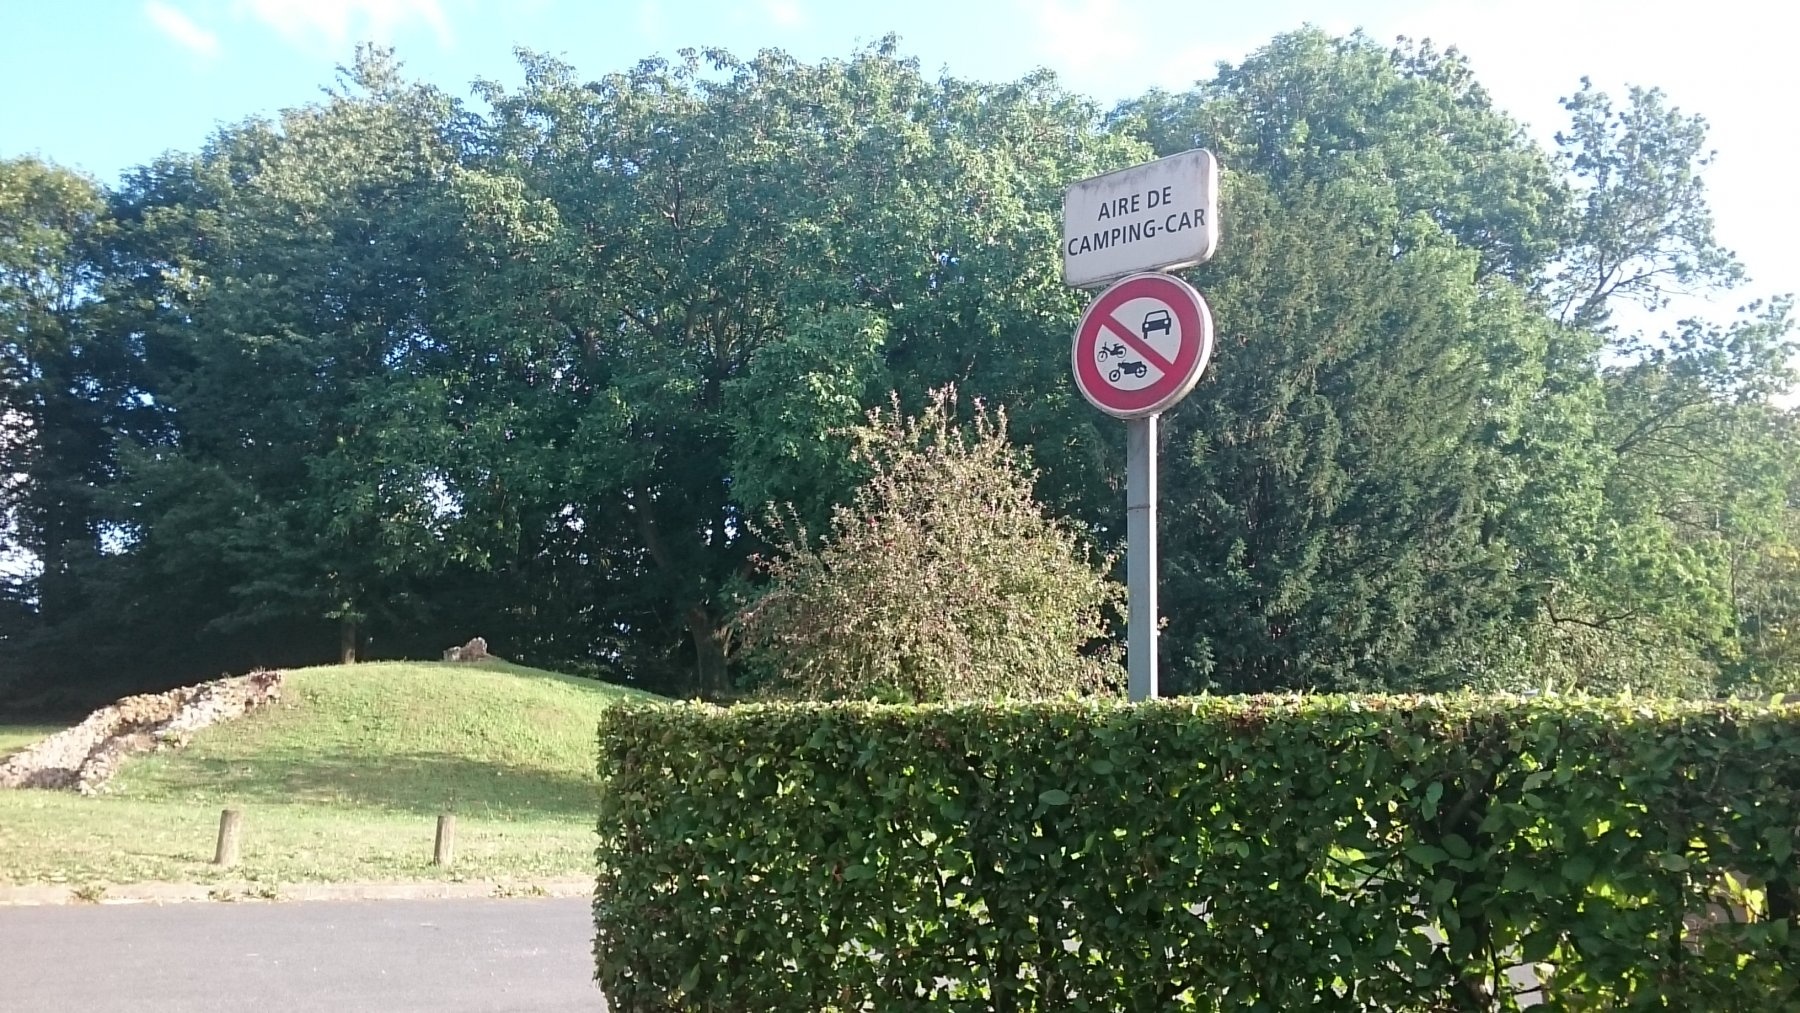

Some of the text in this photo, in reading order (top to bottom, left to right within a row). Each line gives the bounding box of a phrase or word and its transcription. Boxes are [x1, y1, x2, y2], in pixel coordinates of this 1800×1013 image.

[1098, 186, 1172, 221] AIRE DE
[1068, 208, 1205, 256] CAMPING-CAR
